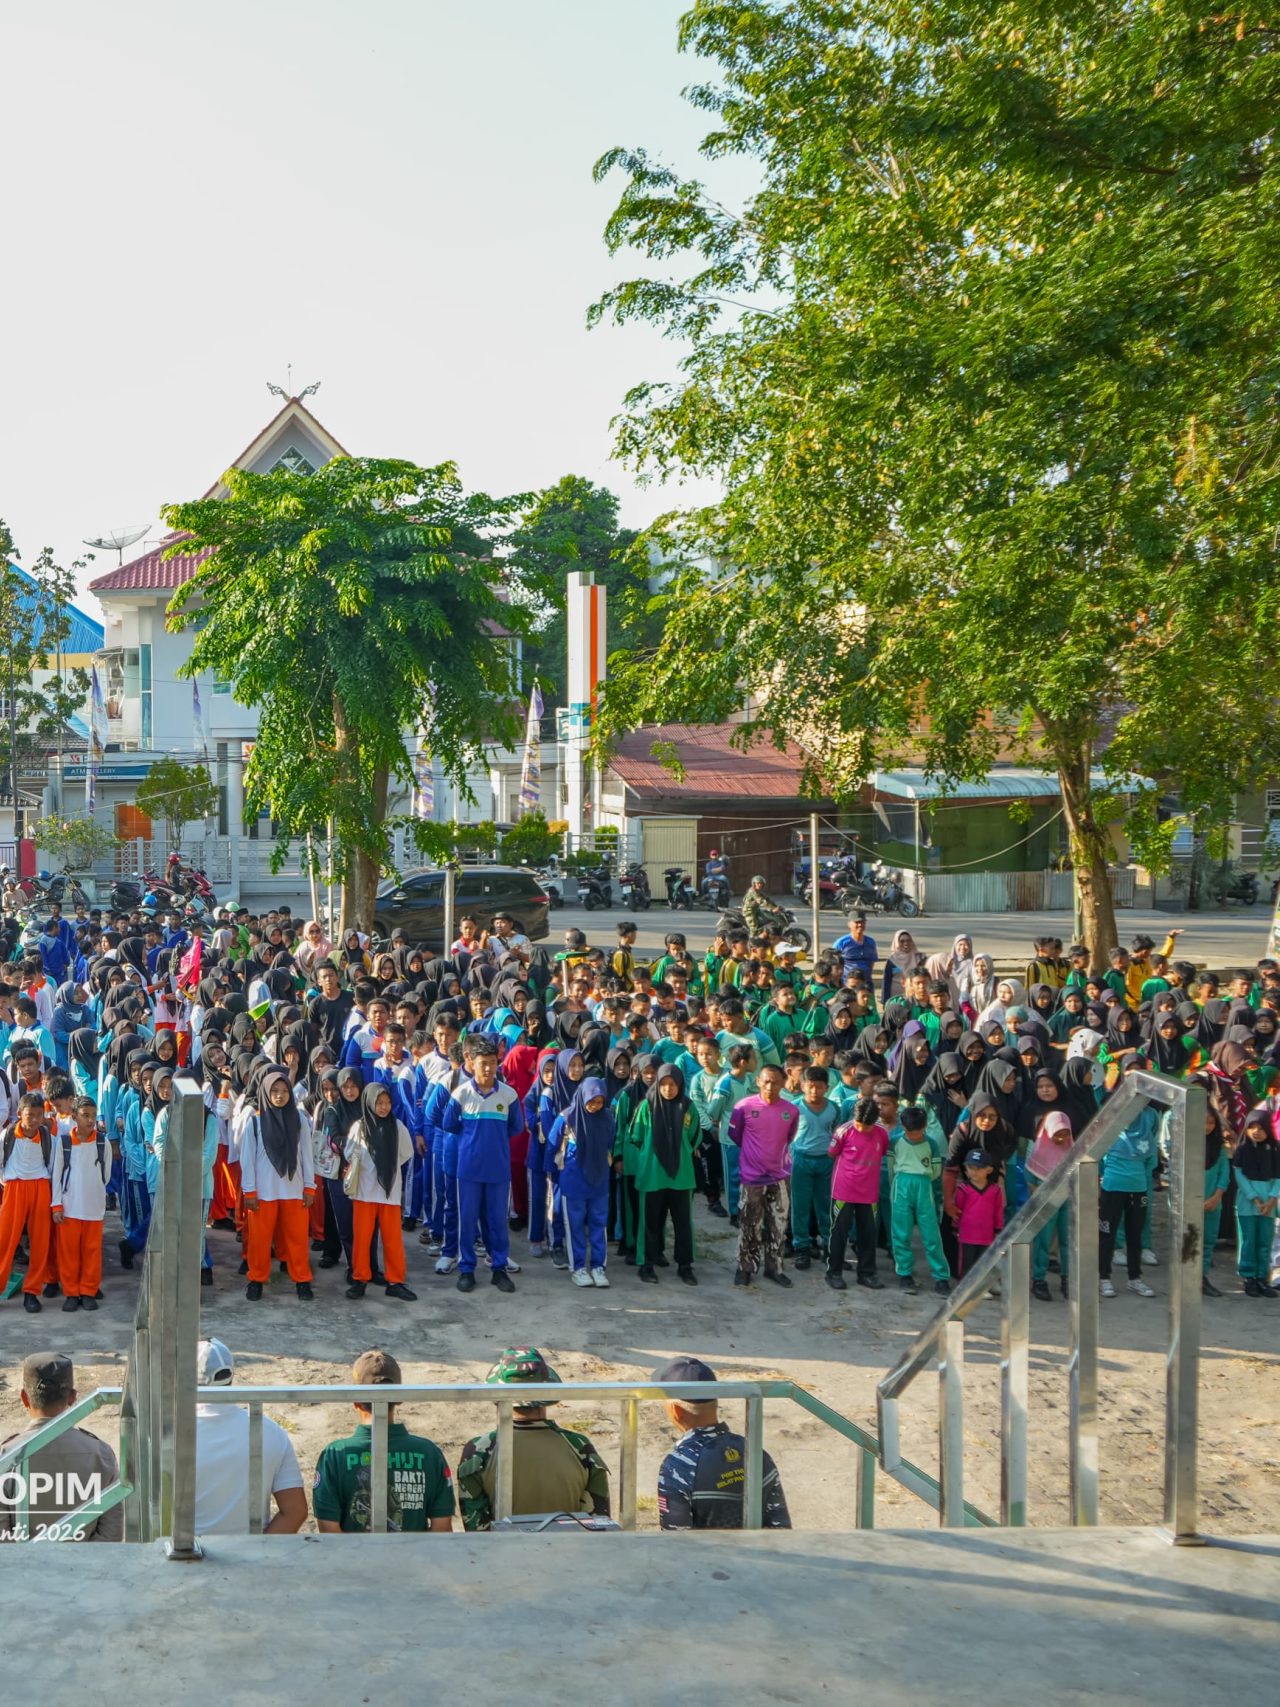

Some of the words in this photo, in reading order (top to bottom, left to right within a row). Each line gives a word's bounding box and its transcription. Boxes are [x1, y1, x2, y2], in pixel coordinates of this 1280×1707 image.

[346, 1451, 425, 1471] POHUT
[394, 1471, 425, 1483] BAKTI
[394, 1483, 426, 1493] NEGERI
